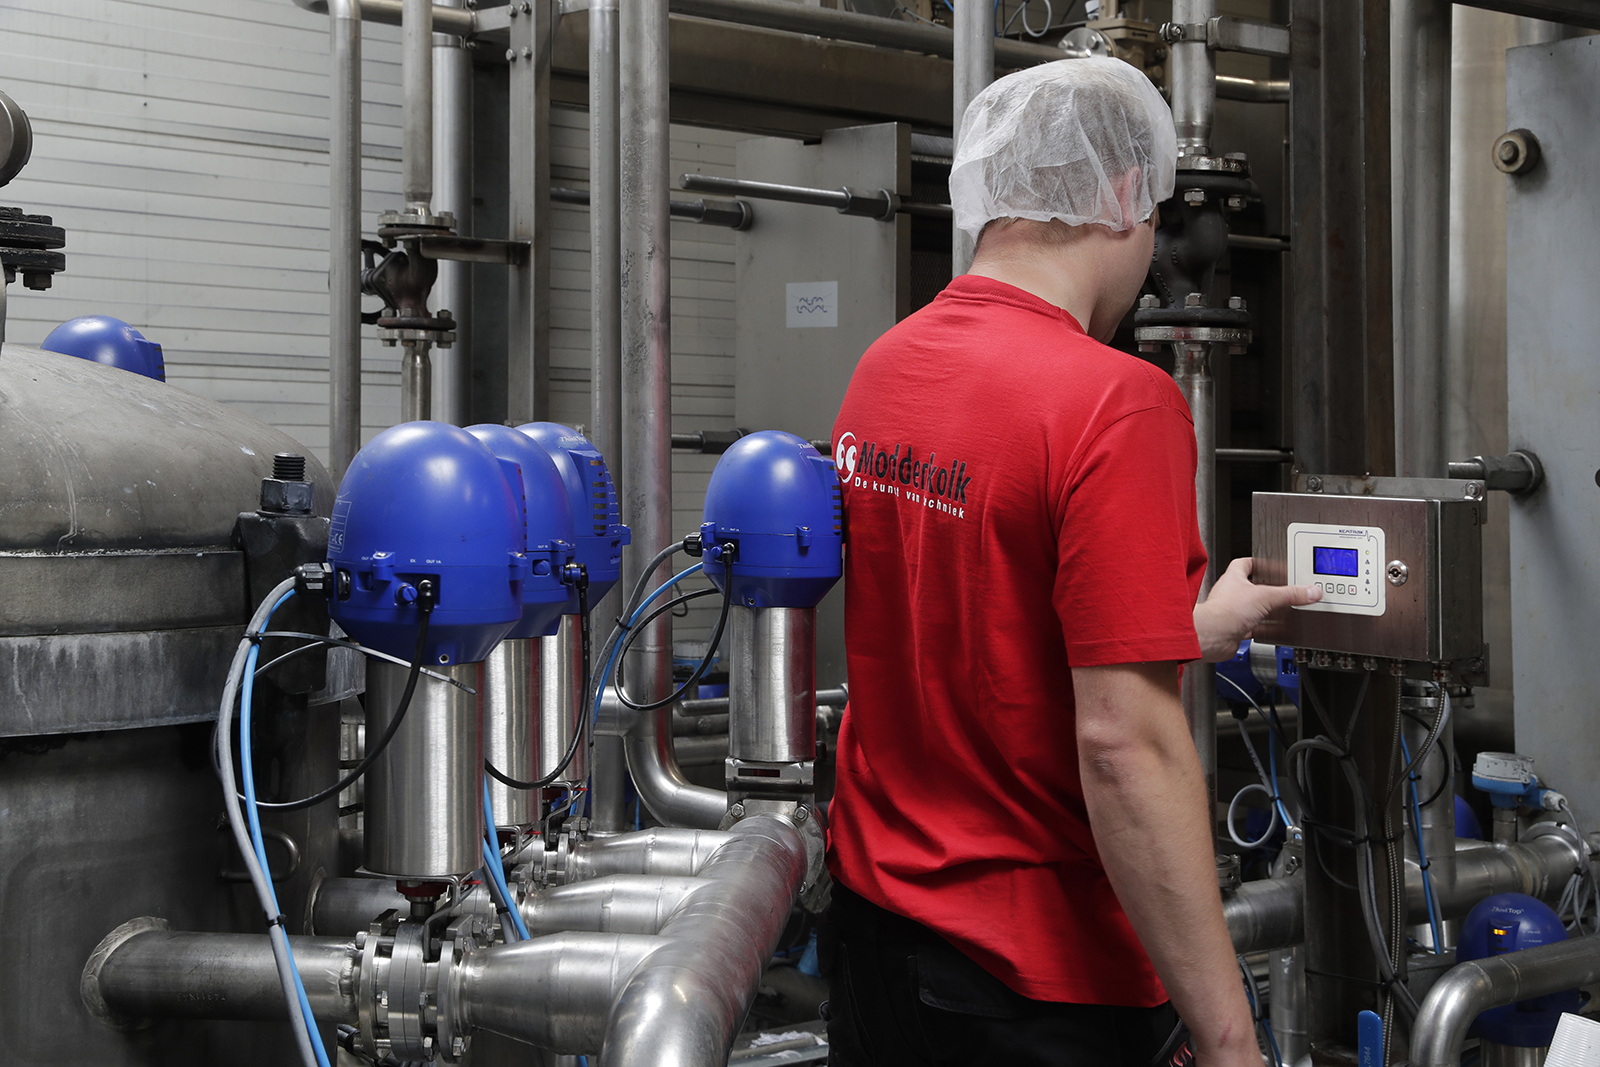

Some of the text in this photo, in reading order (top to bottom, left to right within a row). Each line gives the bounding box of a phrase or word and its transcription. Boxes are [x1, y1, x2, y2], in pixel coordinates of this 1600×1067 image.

[854, 476, 868, 489] De
[906, 490, 921, 503] van
[856, 441, 972, 505] Modderkolk
